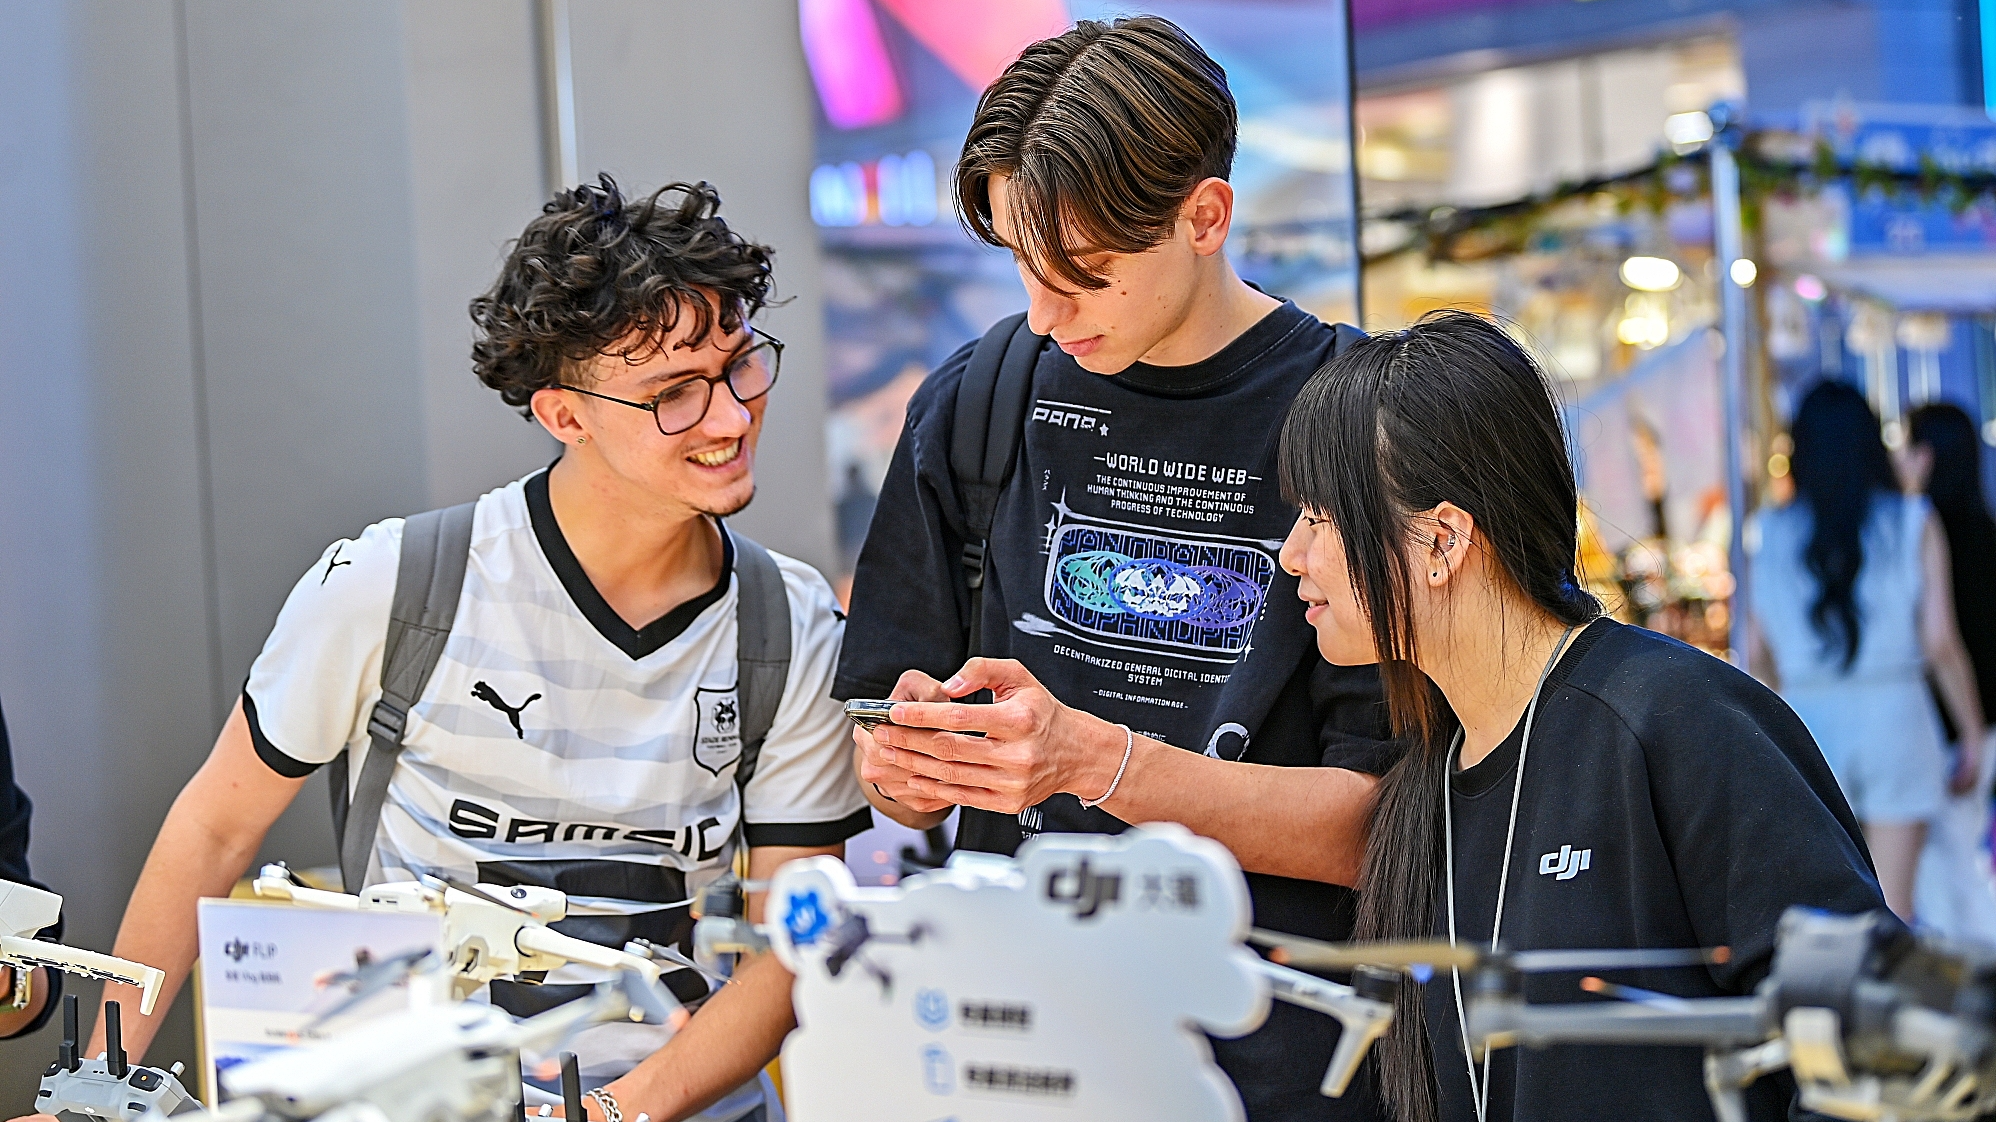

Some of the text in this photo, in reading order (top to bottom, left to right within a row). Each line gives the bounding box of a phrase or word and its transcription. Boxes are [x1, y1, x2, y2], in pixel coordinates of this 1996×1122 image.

[1163, 461, 1207, 481] WIDE
[1096, 474, 1247, 502] THE CONTINUOUS IMPROVEMENT OF
[1087, 484, 1255, 515] HUMAN THINKING AND THE CONTINUOUS
[1111, 499, 1224, 522] PROGRESS OF TECHNOLOGY
[1124, 662, 1162, 676] GENERAL
[1127, 673, 1163, 687] SYSTEM
[1125, 694, 1171, 707] INFORMATION
